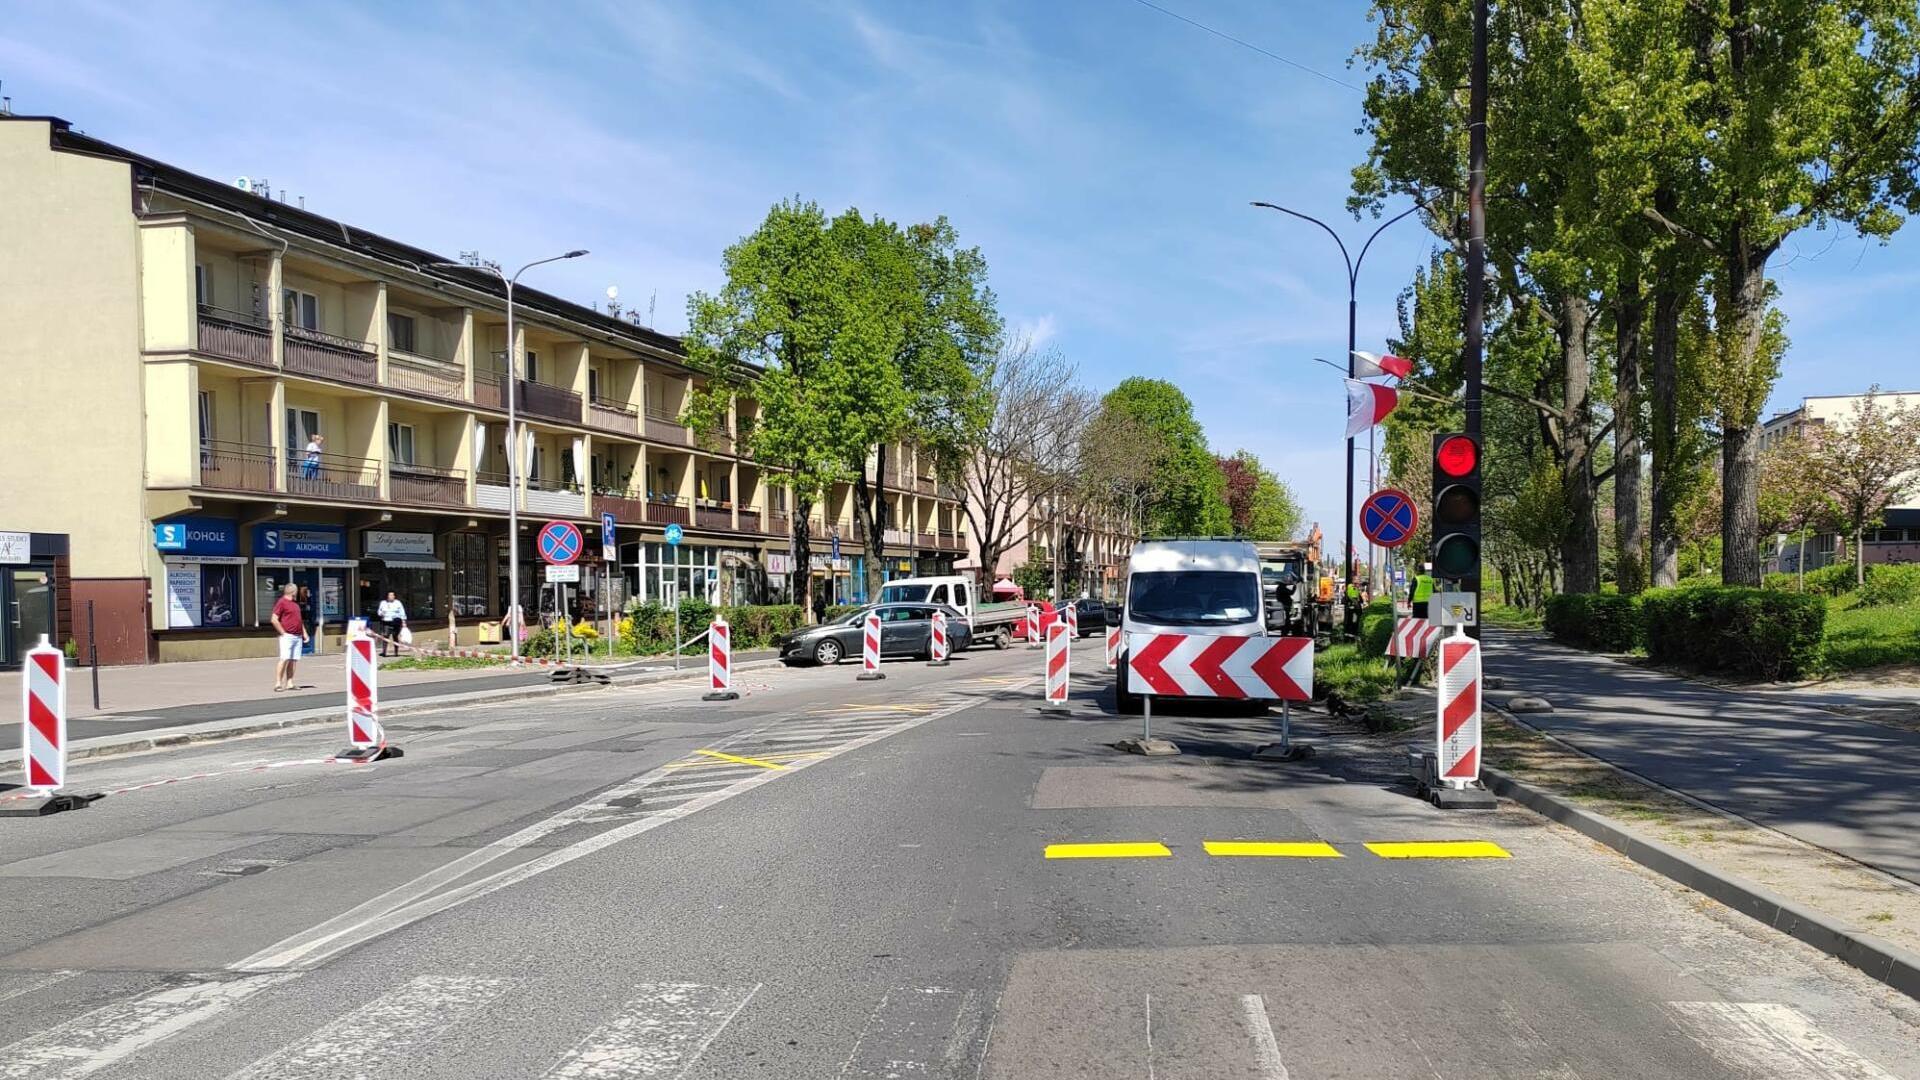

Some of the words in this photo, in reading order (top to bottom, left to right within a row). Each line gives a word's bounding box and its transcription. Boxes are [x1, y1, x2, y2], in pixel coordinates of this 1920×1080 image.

[605, 516, 613, 535] P
[296, 543, 330, 552] ALKOHOLE
[1464, 608, 1473, 621] R
